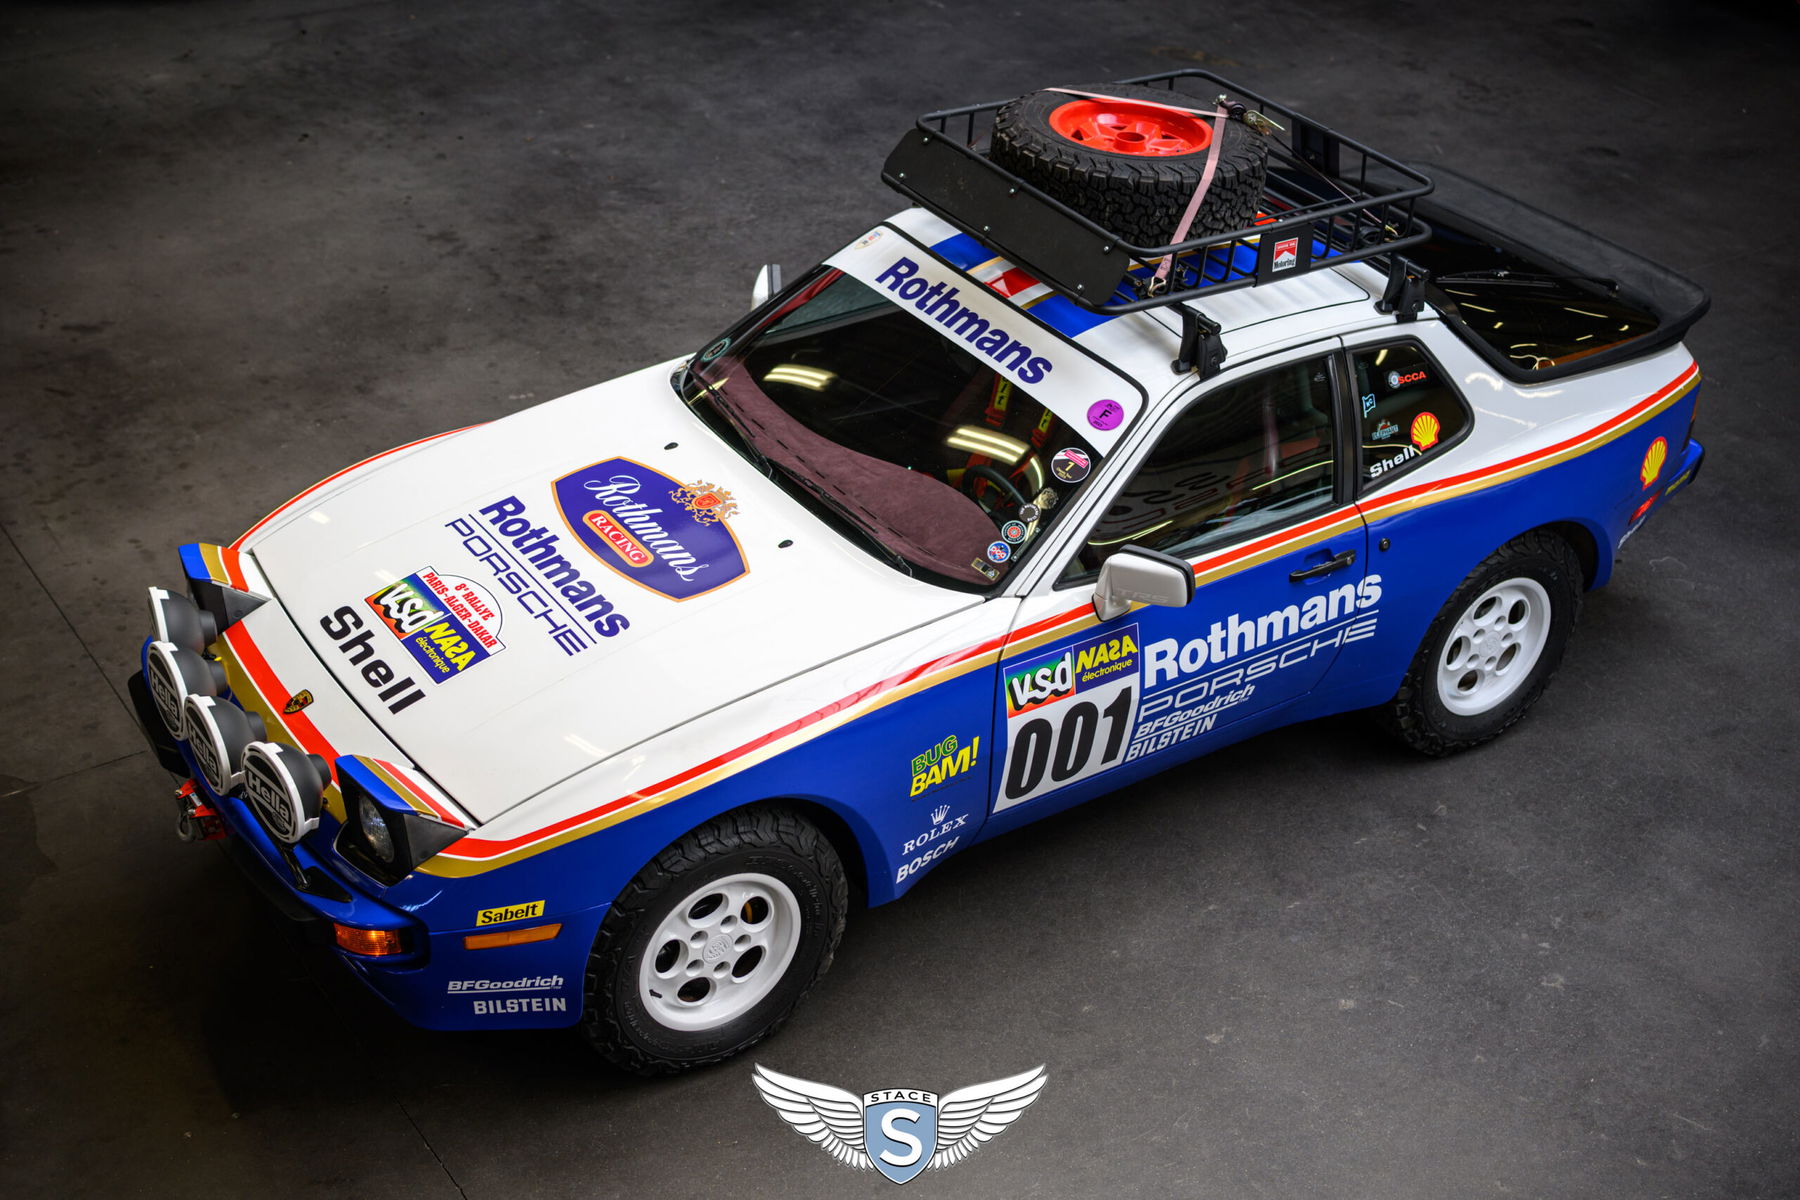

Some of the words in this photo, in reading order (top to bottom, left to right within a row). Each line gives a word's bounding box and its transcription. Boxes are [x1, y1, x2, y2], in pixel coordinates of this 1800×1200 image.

[875, 256, 1053, 384] Rothmans
[1397, 371, 1426, 384] SCCA
[1099, 409, 1112, 419] F
[1369, 444, 1416, 478] Shell
[583, 475, 709, 582] Rothmans
[591, 515, 646, 562] RACING
[445, 518, 588, 656] PORSCHE
[478, 495, 630, 638] Rothmans
[462, 589, 495, 622] RALLYE
[423, 621, 476, 672] NASA
[1144, 574, 1382, 689] Rothmans
[320, 606, 426, 715] Shell
[415, 637, 450, 673] électronique
[1075, 635, 1138, 674] NASA
[1081, 658, 1132, 682] électronique
[1137, 618, 1377, 723] PORSCHE
[150, 674, 178, 715] Hella
[1134, 683, 1255, 738] BFGoodrich
[188, 726, 217, 771] Hella
[912, 734, 958, 777] BUG
[1005, 686, 1132, 800] 001
[1125, 714, 1217, 763] BILSTEIN
[910, 736, 980, 797] BAM!
[248, 776, 290, 819] Hella
[902, 814, 969, 856] ROLEX
[896, 836, 960, 884] BOSCH
[481, 903, 538, 924] Sabelt
[447, 975, 564, 991] BFGoodrich
[473, 997, 566, 1015] BILSTEIN
